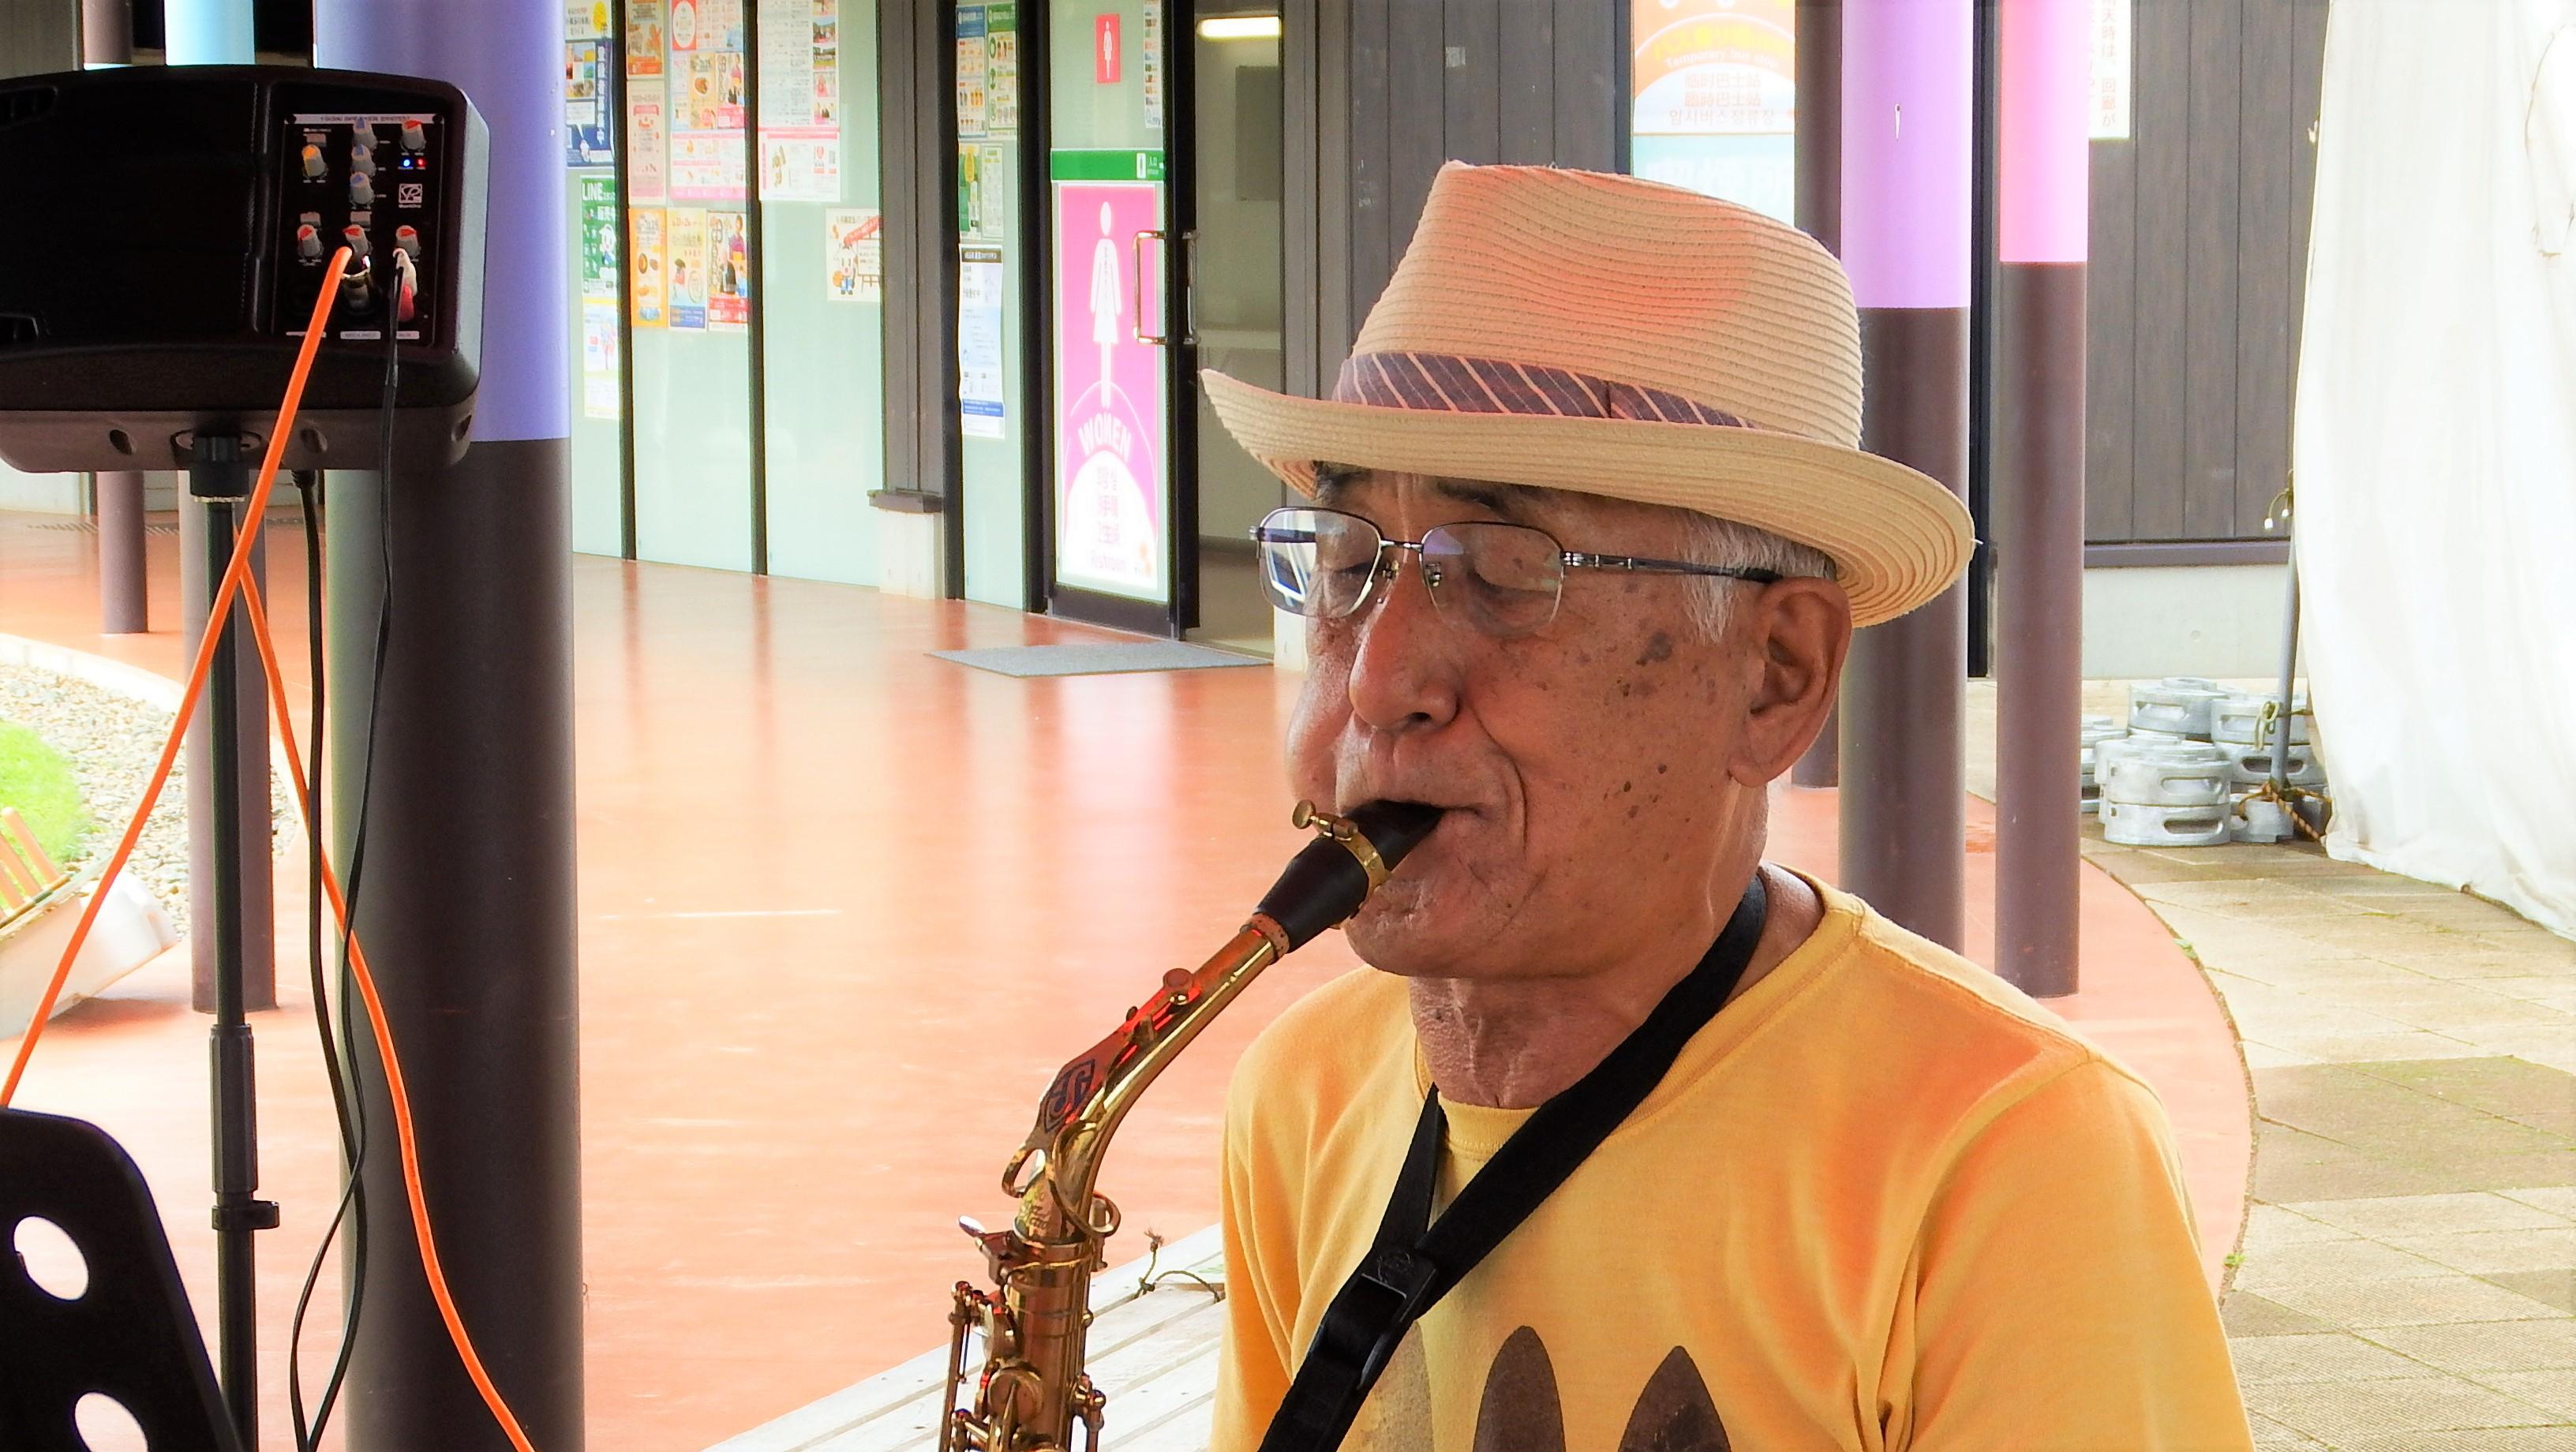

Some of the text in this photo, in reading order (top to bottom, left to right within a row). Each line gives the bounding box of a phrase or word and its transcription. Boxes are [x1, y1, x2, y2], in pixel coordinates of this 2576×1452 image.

[1666, 49, 1727, 68] Temporary
[1730, 47, 1750, 60] bus
[1684, 91, 1762, 107] 臨時巴士站
[1668, 109, 1775, 126] 임시버스정류장
[582, 182, 603, 201] LINE
[1077, 412, 1133, 462] WOMEN
